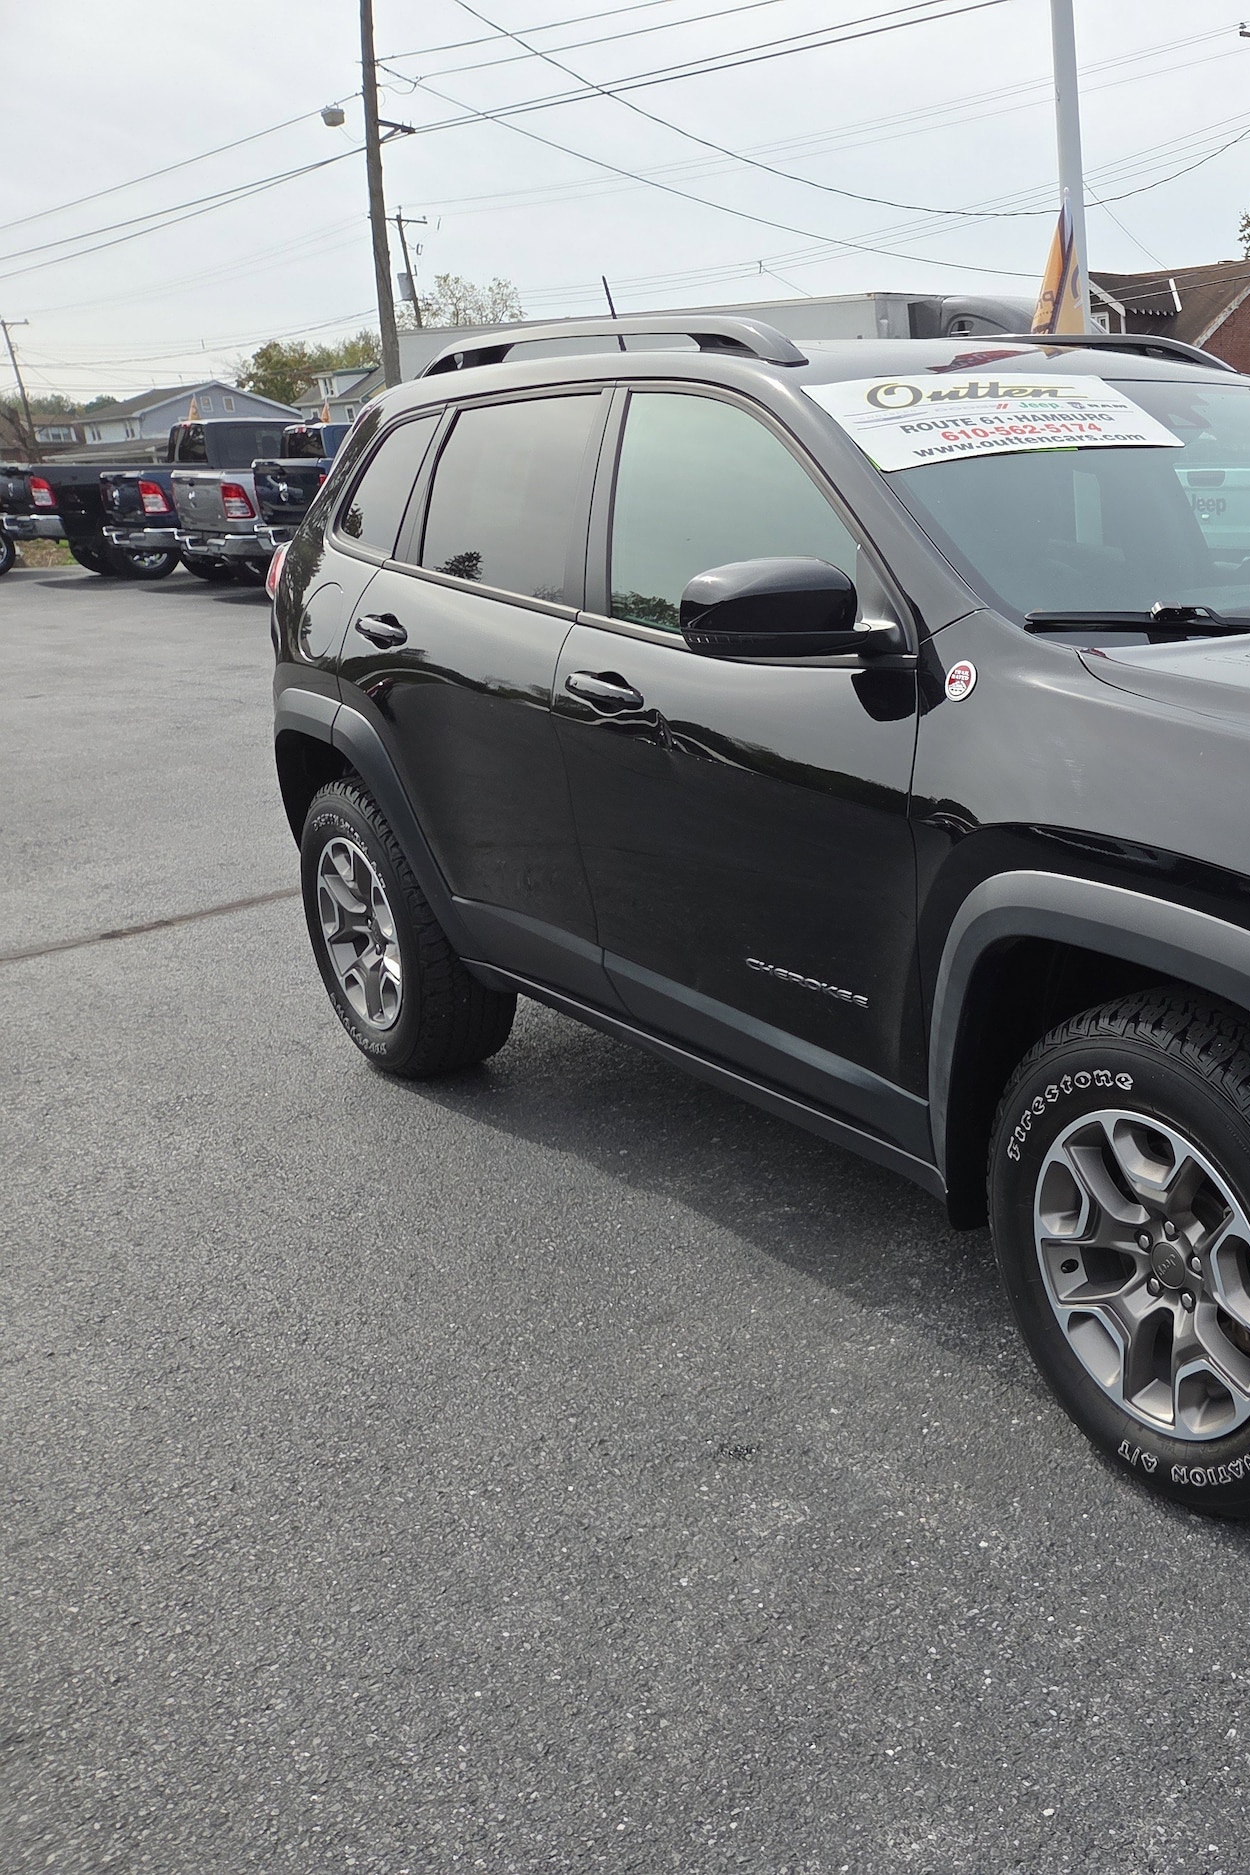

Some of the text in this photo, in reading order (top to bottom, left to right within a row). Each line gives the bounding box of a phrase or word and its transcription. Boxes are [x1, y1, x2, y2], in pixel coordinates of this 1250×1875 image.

[866, 382, 1088, 409] Outten
[1018, 401, 1060, 410] Jeep
[899, 413, 1116, 434] ROUTE 61 HAMBURG
[940, 422, 1103, 442] 610-562-5174
[913, 433, 1147, 458] www.outtencars.com
[1191, 493, 1226, 516] Jeep
[746, 958, 869, 1008] CHEROKEE
[1118, 1439, 1159, 1473] A/T
